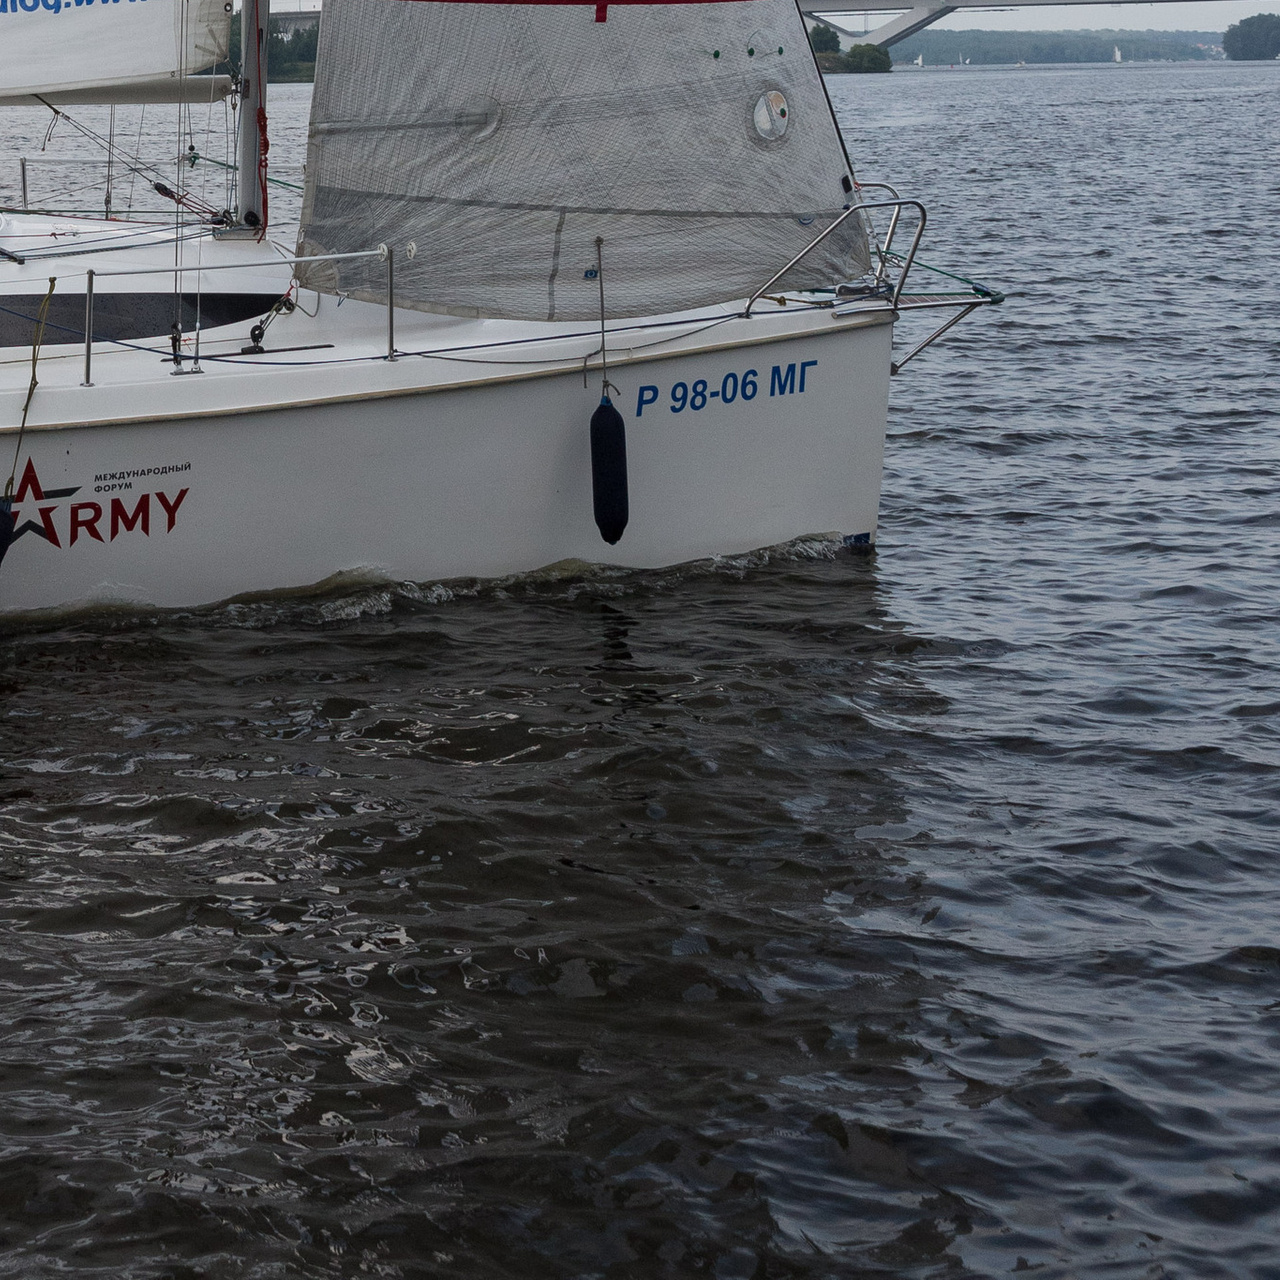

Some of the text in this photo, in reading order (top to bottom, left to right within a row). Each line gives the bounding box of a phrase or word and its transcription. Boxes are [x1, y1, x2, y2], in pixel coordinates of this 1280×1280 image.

[670, 369, 758, 414] 98-06
[769, 360, 818, 397] МГ
[94, 462, 192, 482] МЕЖДУНАРОДНЫЙ
[94, 482, 132, 493] ФОРУМ
[11, 456, 190, 549] ARMY
